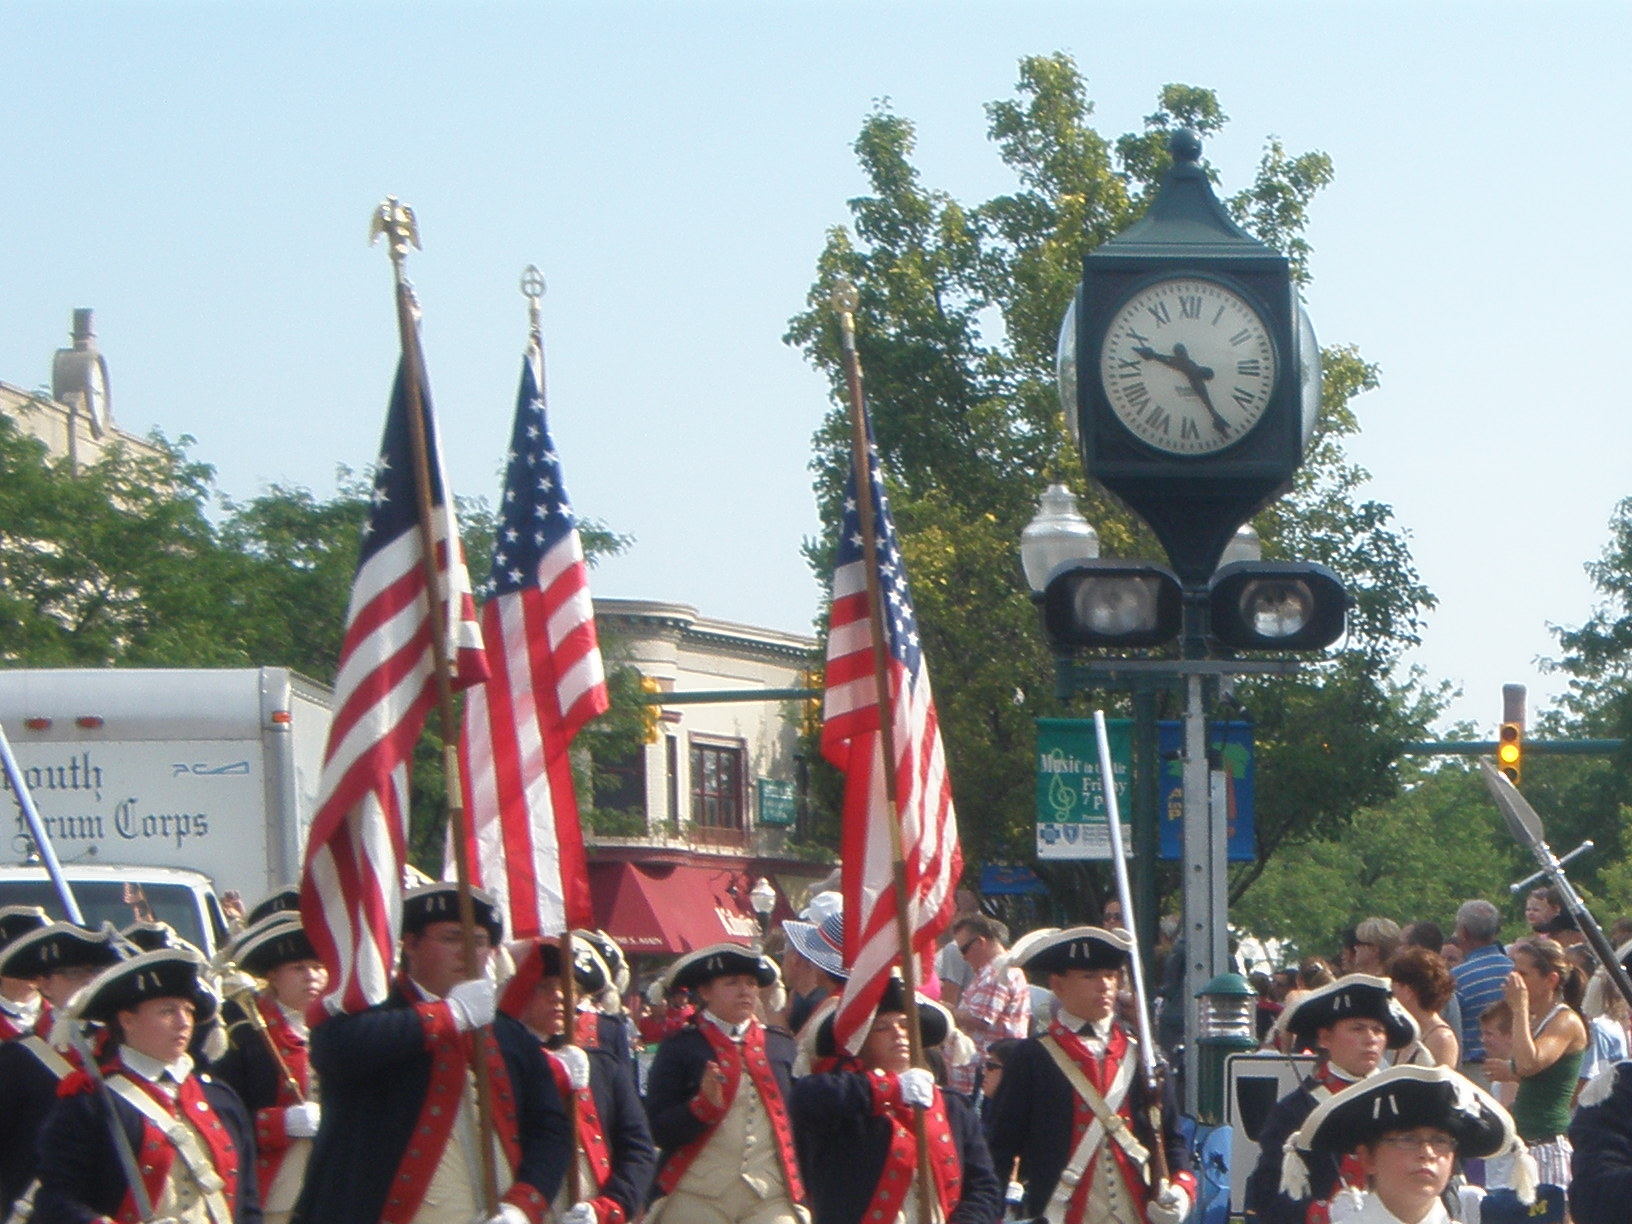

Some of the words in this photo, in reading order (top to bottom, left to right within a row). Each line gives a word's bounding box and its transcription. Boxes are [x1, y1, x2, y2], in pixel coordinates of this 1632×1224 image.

[1148, 301, 1171, 328] XI
[1178, 295, 1202, 319] XII
[1125, 327, 1149, 347] X
[1237, 359, 1261, 377] III
[1181, 416, 1200, 440] VI
[1041, 753, 1080, 774] Music
[1082, 777, 1127, 797] Friay
[115, 798, 209, 849] Corps
